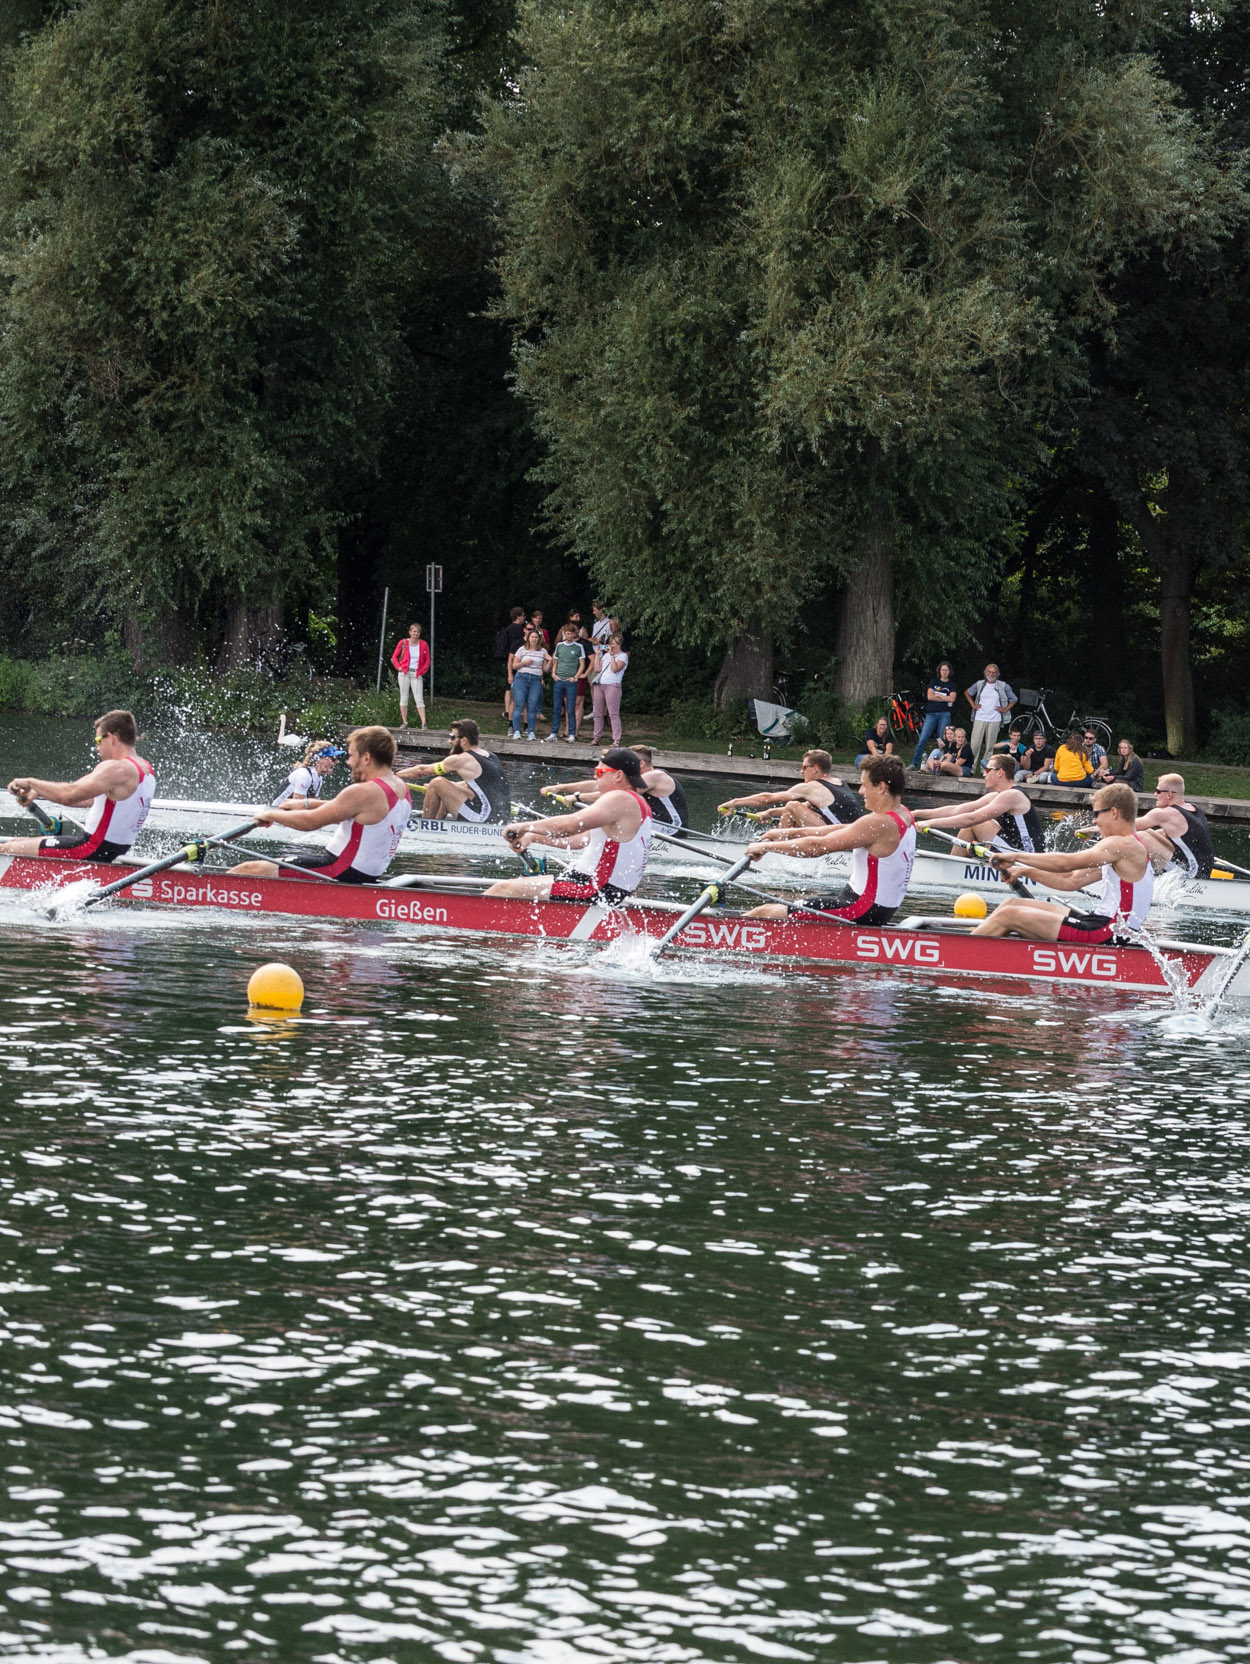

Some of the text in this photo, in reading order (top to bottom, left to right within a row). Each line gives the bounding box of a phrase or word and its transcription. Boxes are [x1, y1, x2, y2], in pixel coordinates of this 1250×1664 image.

[421, 820, 448, 831] RBL
[161, 881, 262, 906] Sparkasse
[376, 899, 448, 922] Gießen
[684, 922, 766, 948] SWG
[856, 936, 940, 962] SWG
[1032, 950, 1117, 976] SWG
